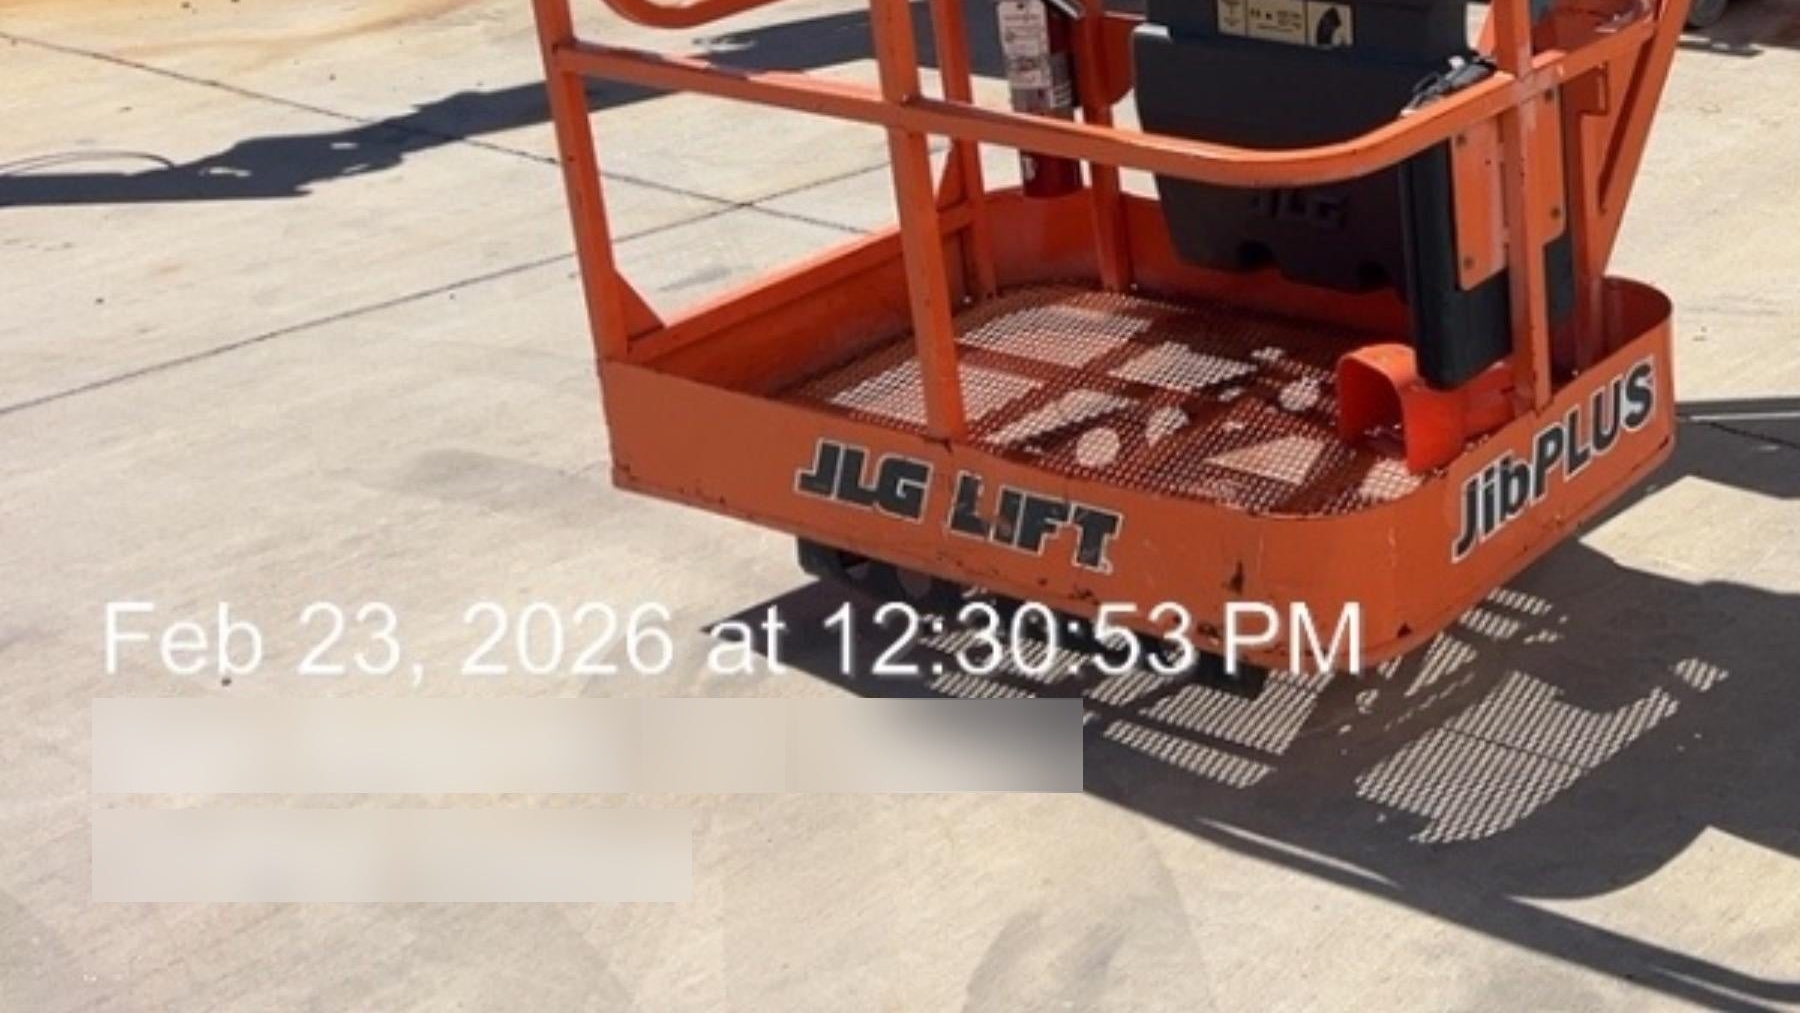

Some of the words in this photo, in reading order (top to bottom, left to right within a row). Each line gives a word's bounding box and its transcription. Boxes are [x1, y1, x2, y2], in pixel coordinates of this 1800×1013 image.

[794, 438, 934, 523] JLG
[945, 470, 1123, 571] LIFT
[1451, 355, 1655, 564] JibPLUS
